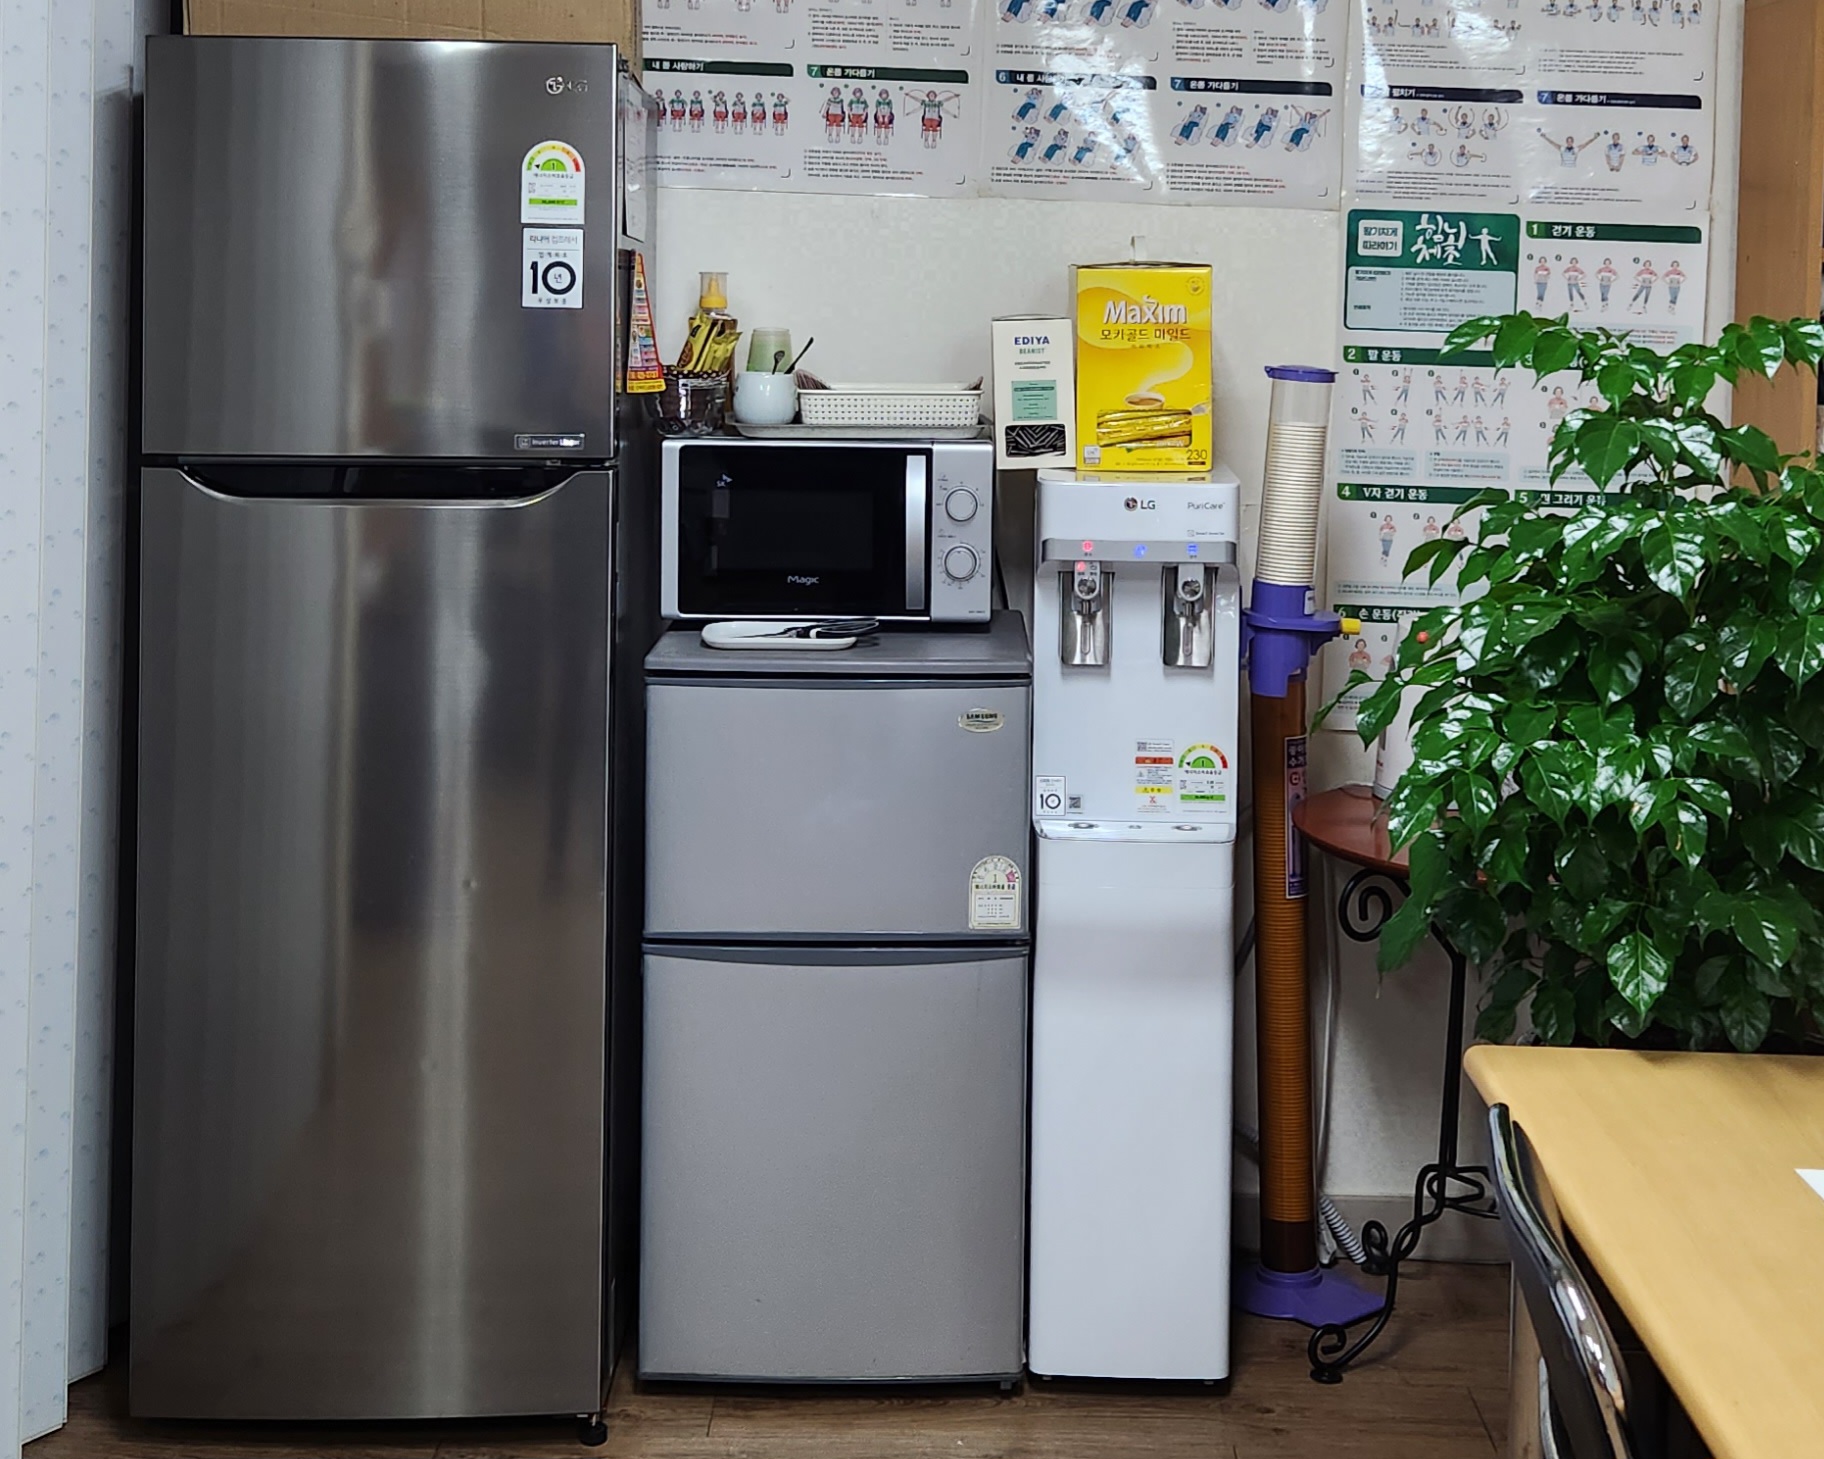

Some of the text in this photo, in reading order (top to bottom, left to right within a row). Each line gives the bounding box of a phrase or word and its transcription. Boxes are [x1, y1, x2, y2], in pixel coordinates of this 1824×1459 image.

[651, 60, 660, 70] 내
[810, 67, 818, 77] 7
[999, 72, 1007, 82] 6
[1174, 80, 1182, 89] 7
[1541, 92, 1549, 102] 7
[1531, 223, 1597, 238] 1 걷기 운동
[530, 260, 577, 295] 10
[1103, 297, 1188, 325] Maxim
[1014, 335, 1050, 346] EDIYA
[1100, 328, 1150, 342] 모카골드
[1347, 348, 1356, 360] 2
[1381, 349, 1402, 362] 운동
[1186, 449, 1208, 460] 230
[1341, 485, 1428, 501] 4 V자 걷기 운동
[1140, 499, 1156, 510] LG
[1519, 492, 1528, 504] 5
[1553, 494, 1583, 506] 그리기
[1187, 501, 1224, 510] PuriCare
[787, 575, 820, 586] Magic
[1338, 606, 1347, 618] 6
[1358, 608, 1369, 620] 손
[1040, 793, 1061, 809] 10
